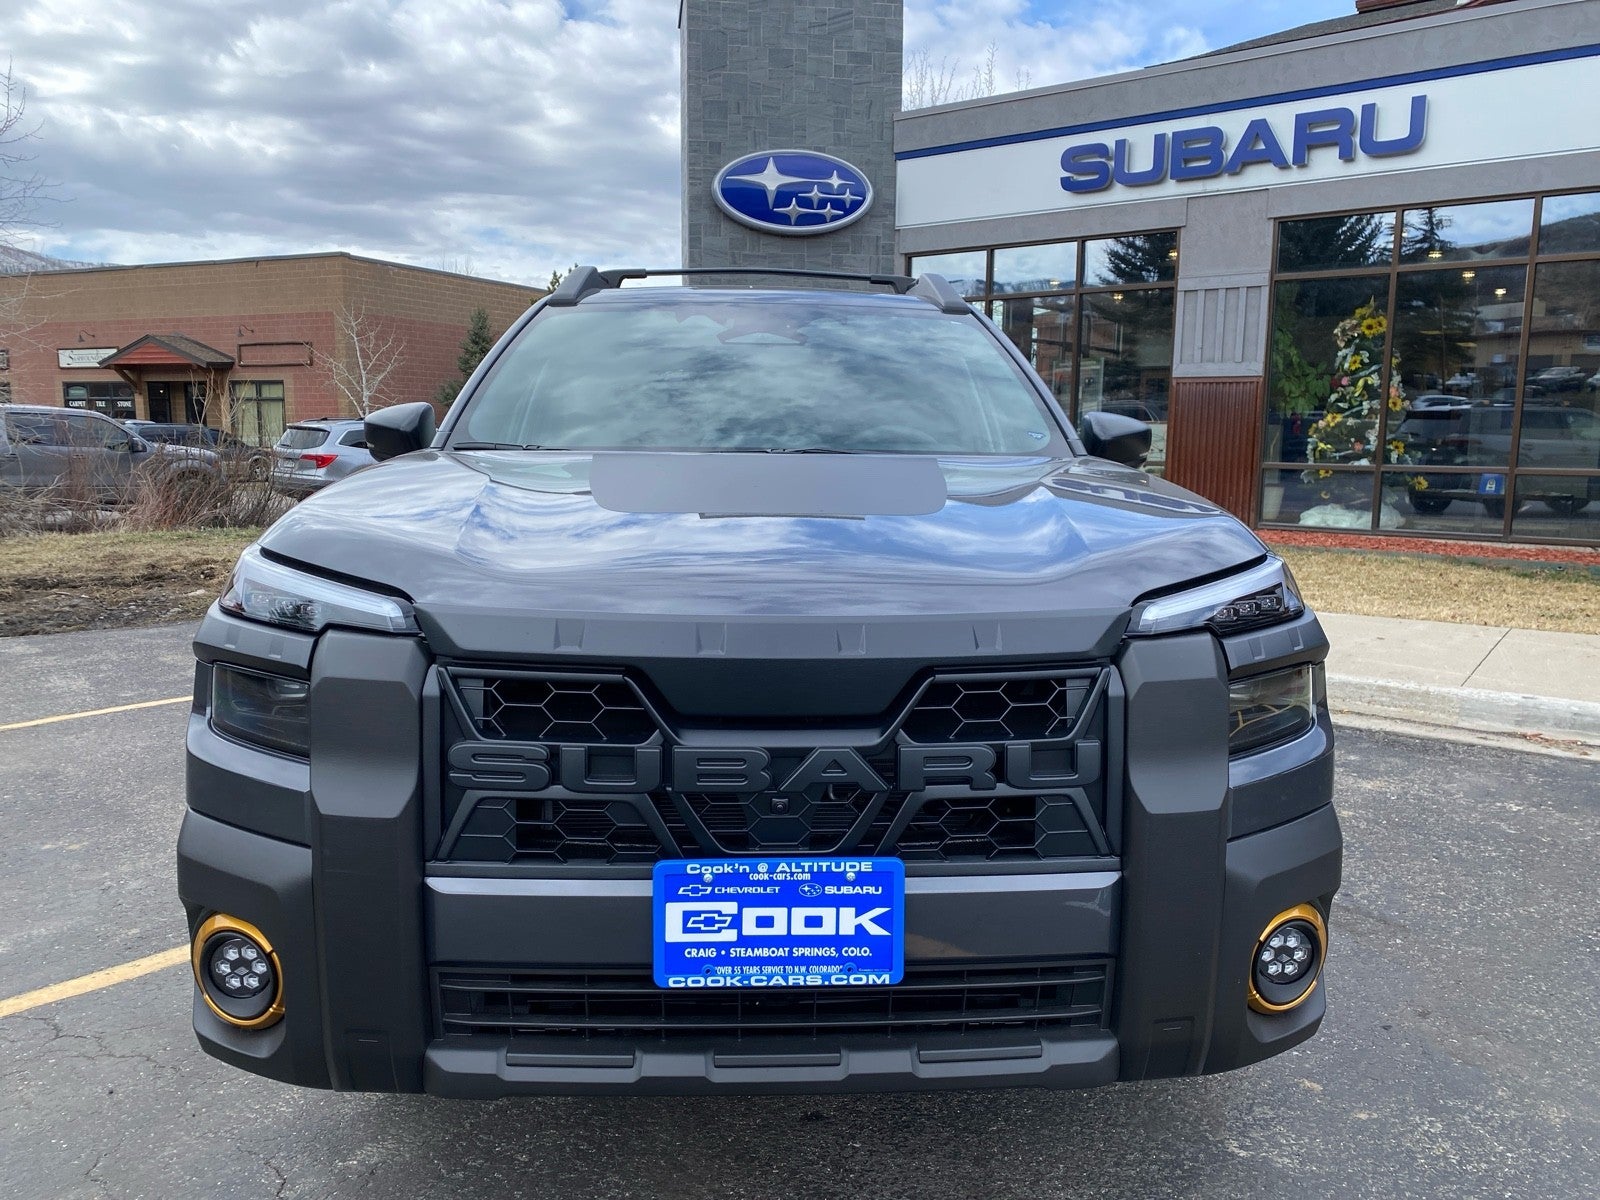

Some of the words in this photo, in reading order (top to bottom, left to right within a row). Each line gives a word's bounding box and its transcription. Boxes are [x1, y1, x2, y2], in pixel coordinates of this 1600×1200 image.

[1060, 94, 1428, 193] SUBARU
[447, 740, 1101, 792] SUBARU
[686, 863, 750, 874] Cook'n
[757, 862, 769, 873] @
[776, 861, 873, 873] ALTITUDE
[749, 872, 811, 881] cook-cars.com
[714, 886, 781, 894] CHEVROLET
[824, 885, 883, 895] SUBARU
[665, 901, 892, 942] COOK
[684, 947, 717, 958] CRAIG
[729, 947, 790, 958] STEAMBOAT
[792, 947, 839, 958] SPRINGS,
[841, 946, 873, 957] COLO.
[734, 965, 741, 975] 55
[743, 965, 760, 975] YEARS
[762, 965, 784, 975] SERVICE
[785, 965, 793, 974] TO
[794, 965, 807, 974] N.W.
[668, 974, 890, 988] COOK-CARS.COM
